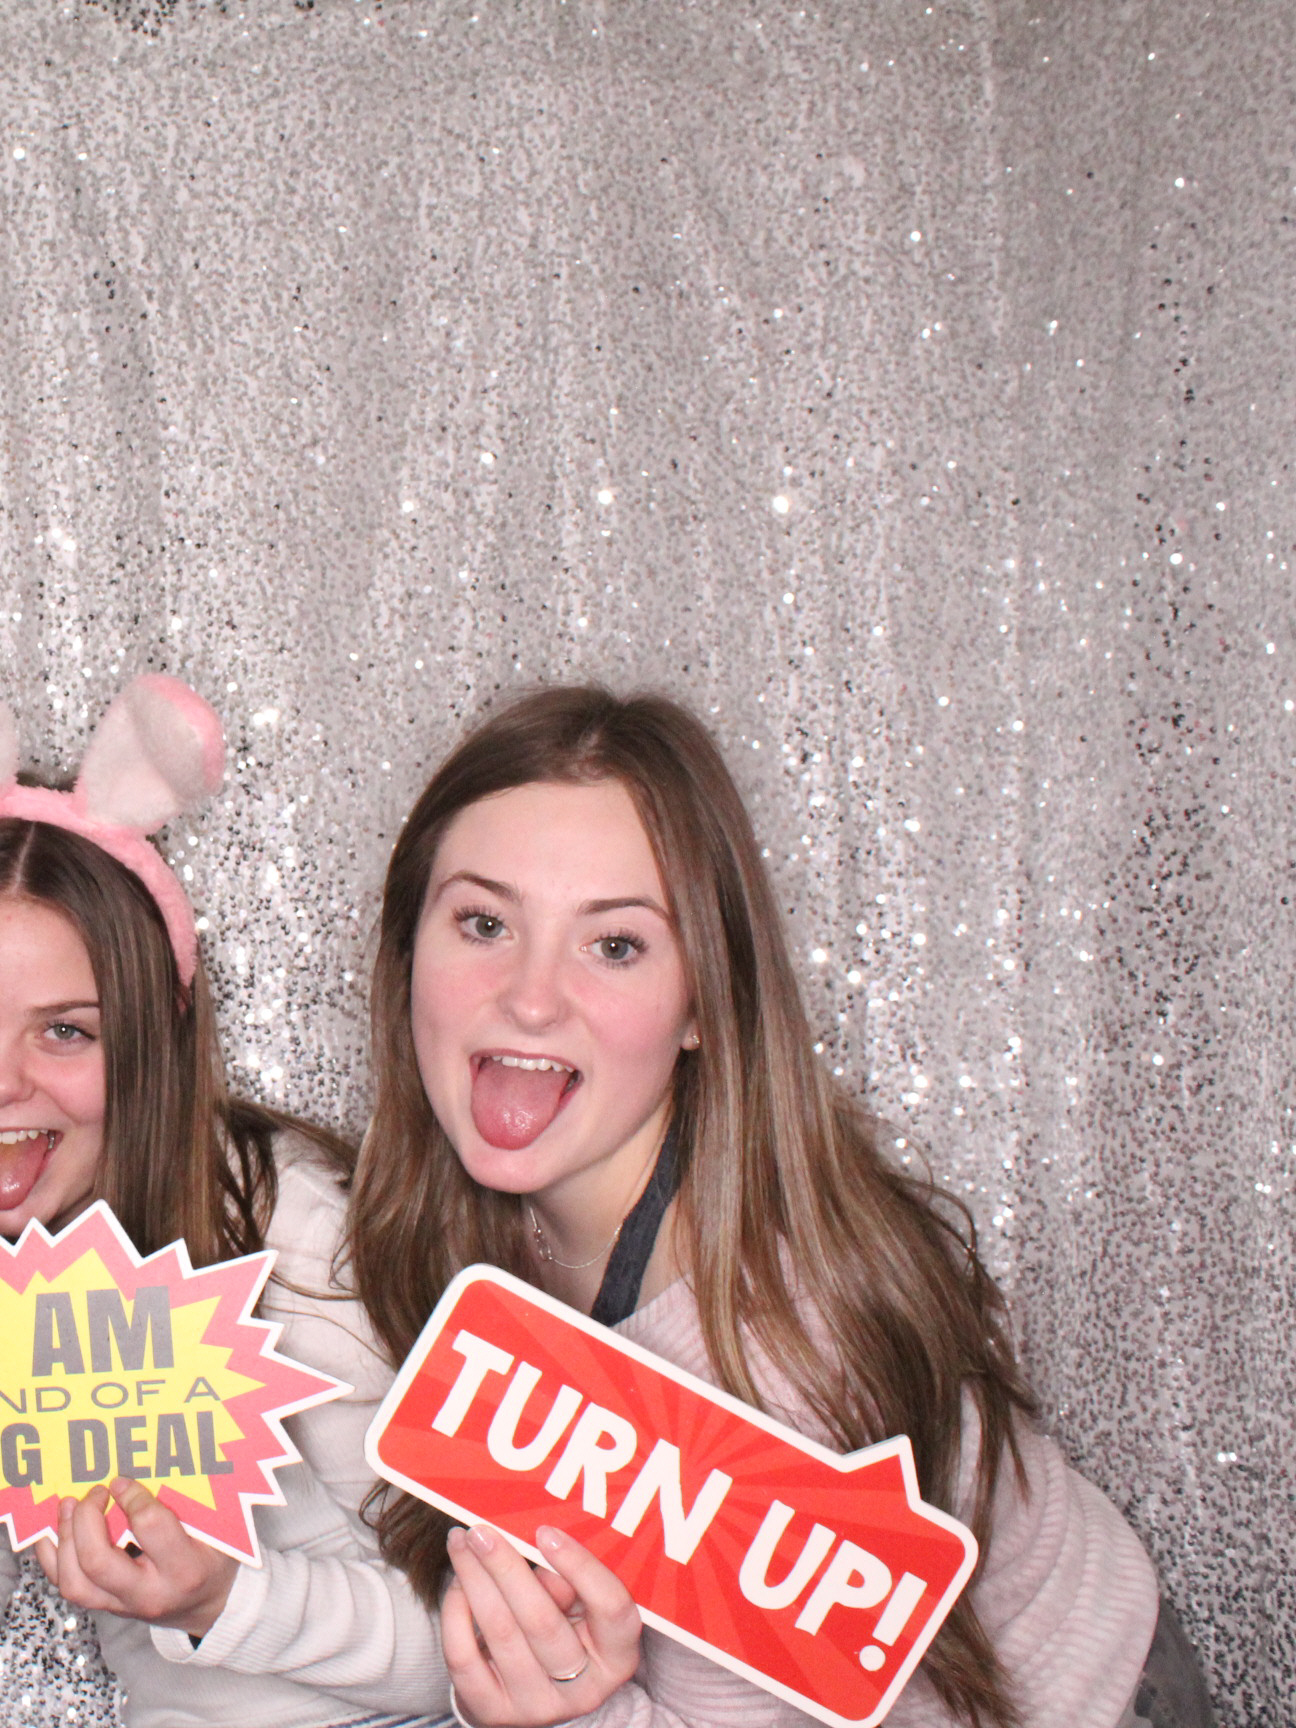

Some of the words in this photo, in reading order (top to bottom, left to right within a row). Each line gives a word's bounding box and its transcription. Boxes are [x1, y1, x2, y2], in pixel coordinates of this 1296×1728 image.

[31, 1286, 174, 1376] AM
[91, 1379, 167, 1409] OF
[185, 1377, 221, 1403] A
[68, 1411, 234, 1483] DEAL
[431, 1330, 732, 1564] TURN
[738, 1500, 927, 1671] UP!
